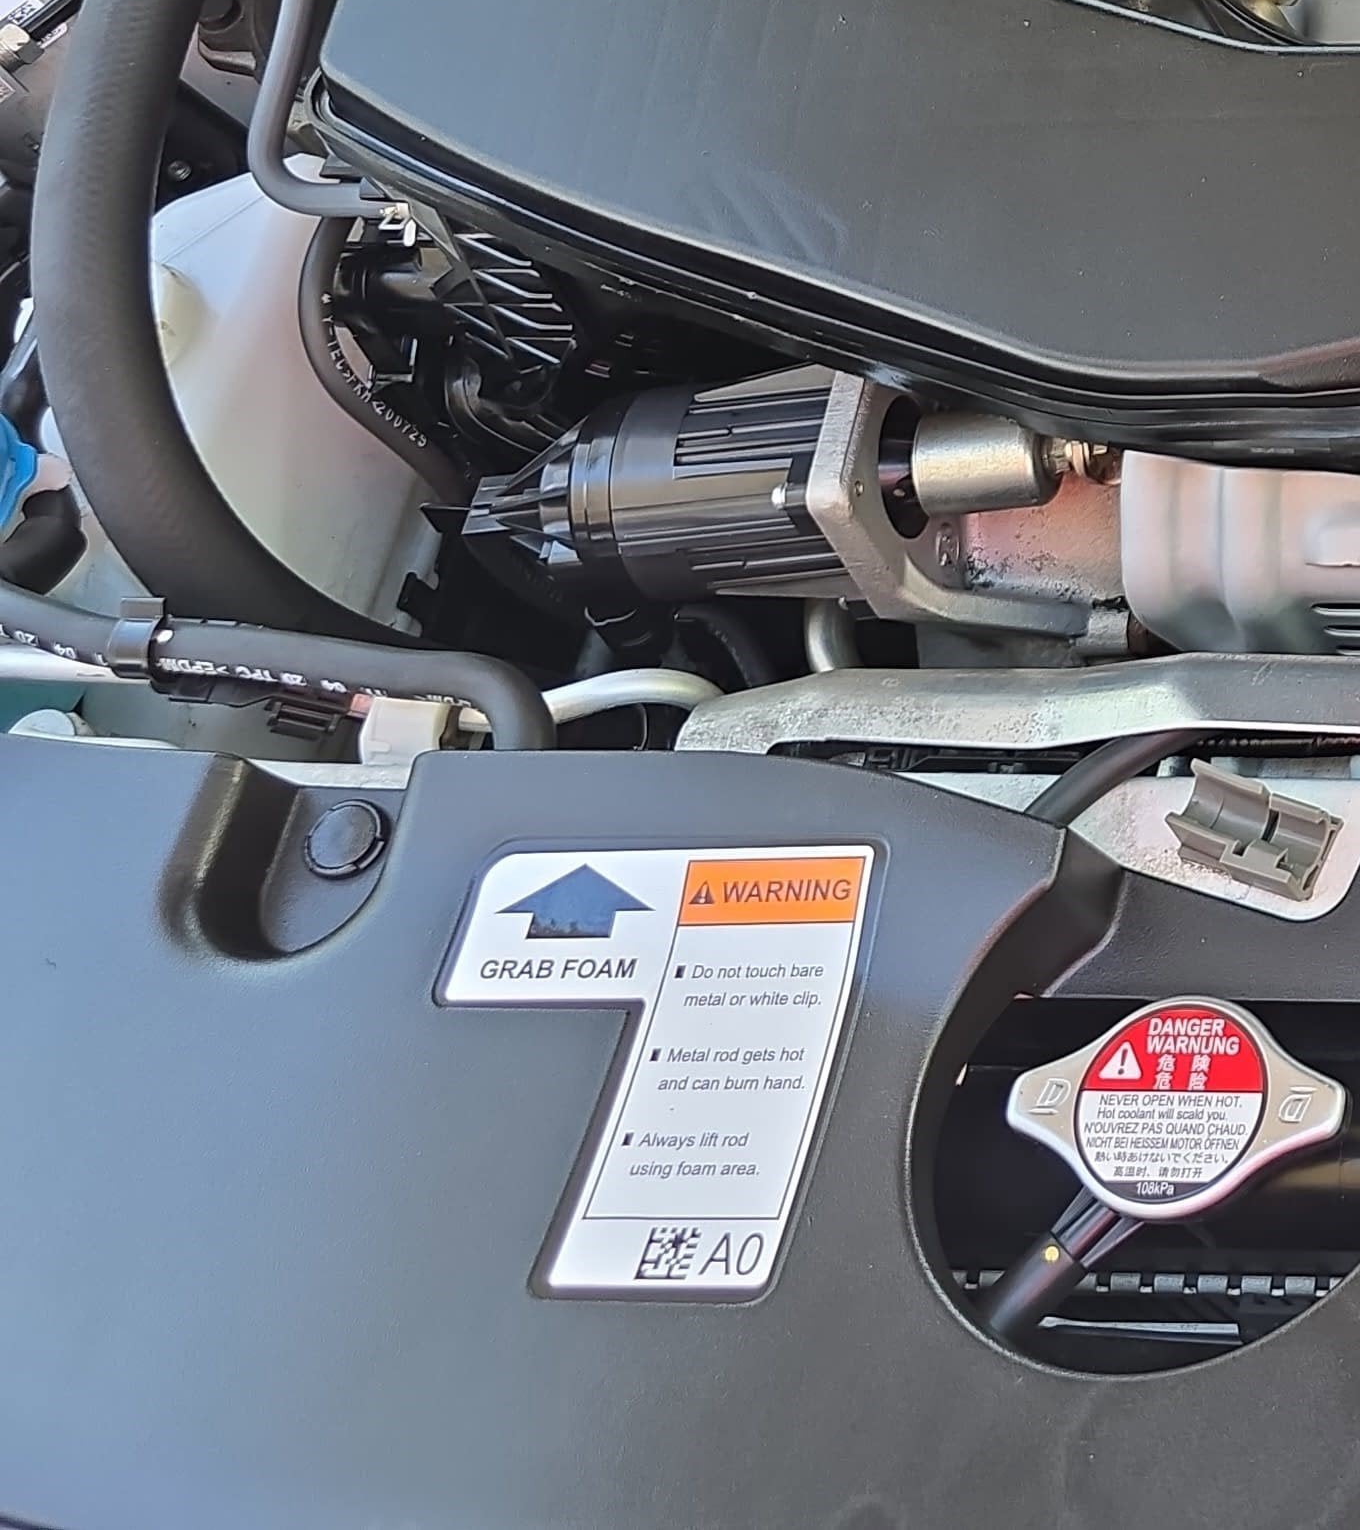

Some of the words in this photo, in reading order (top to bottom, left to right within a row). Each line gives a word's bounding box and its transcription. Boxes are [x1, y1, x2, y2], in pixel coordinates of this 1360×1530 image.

[722, 879, 852, 903] WARNING
[480, 959, 554, 979] GRAB
[560, 958, 637, 979] FOAM
[692, 965, 712, 979] Do
[716, 966, 740, 979] not
[743, 964, 786, 979] touch
[790, 964, 824, 978] bare
[684, 992, 727, 1006] metal
[730, 996, 747, 1006] or
[750, 992, 792, 1006] white
[793, 991, 822, 1009] clip.
[1148, 1019, 1225, 1036] DANGER
[1146, 1036, 1239, 1055] WARNUNG
[667, 1048, 712, 1062] Metal
[715, 1048, 739, 1062] rod
[742, 1050, 775, 1066] gets
[779, 1047, 805, 1061] hot
[658, 1076, 689, 1090] and
[693, 1079, 720, 1090] can
[723, 1076, 760, 1090] burn
[764, 1075, 805, 1090] hand.
[1100, 1094, 1138, 1106] NEVER
[1142, 1095, 1175, 1107] OPEN
[1178, 1096, 1213, 1107] WHEN
[1097, 1108, 1115, 1119] Hot
[1118, 1108, 1156, 1119] coolant
[1158, 1109, 1173, 1119] will
[1176, 1109, 1204, 1120] scald
[1084, 1123, 1137, 1133] N'OUVREZ
[1141, 1123, 1162, 1134] PAS
[1165, 1123, 1205, 1135] QUAND
[638, 1133, 695, 1149] Always
[699, 1133, 718, 1146] lift
[721, 1132, 748, 1146] rod
[1086, 1137, 1112, 1148] NICHT
[1114, 1137, 1129, 1148] BEI
[1130, 1138, 1169, 1148] HEISSEM
[1170, 1138, 1201, 1149] MOTOR
[630, 1162, 672, 1179] using
[677, 1162, 716, 1176] foam
[720, 1164, 760, 1176] area.
[1136, 1182, 1175, 1196] 108kPa
